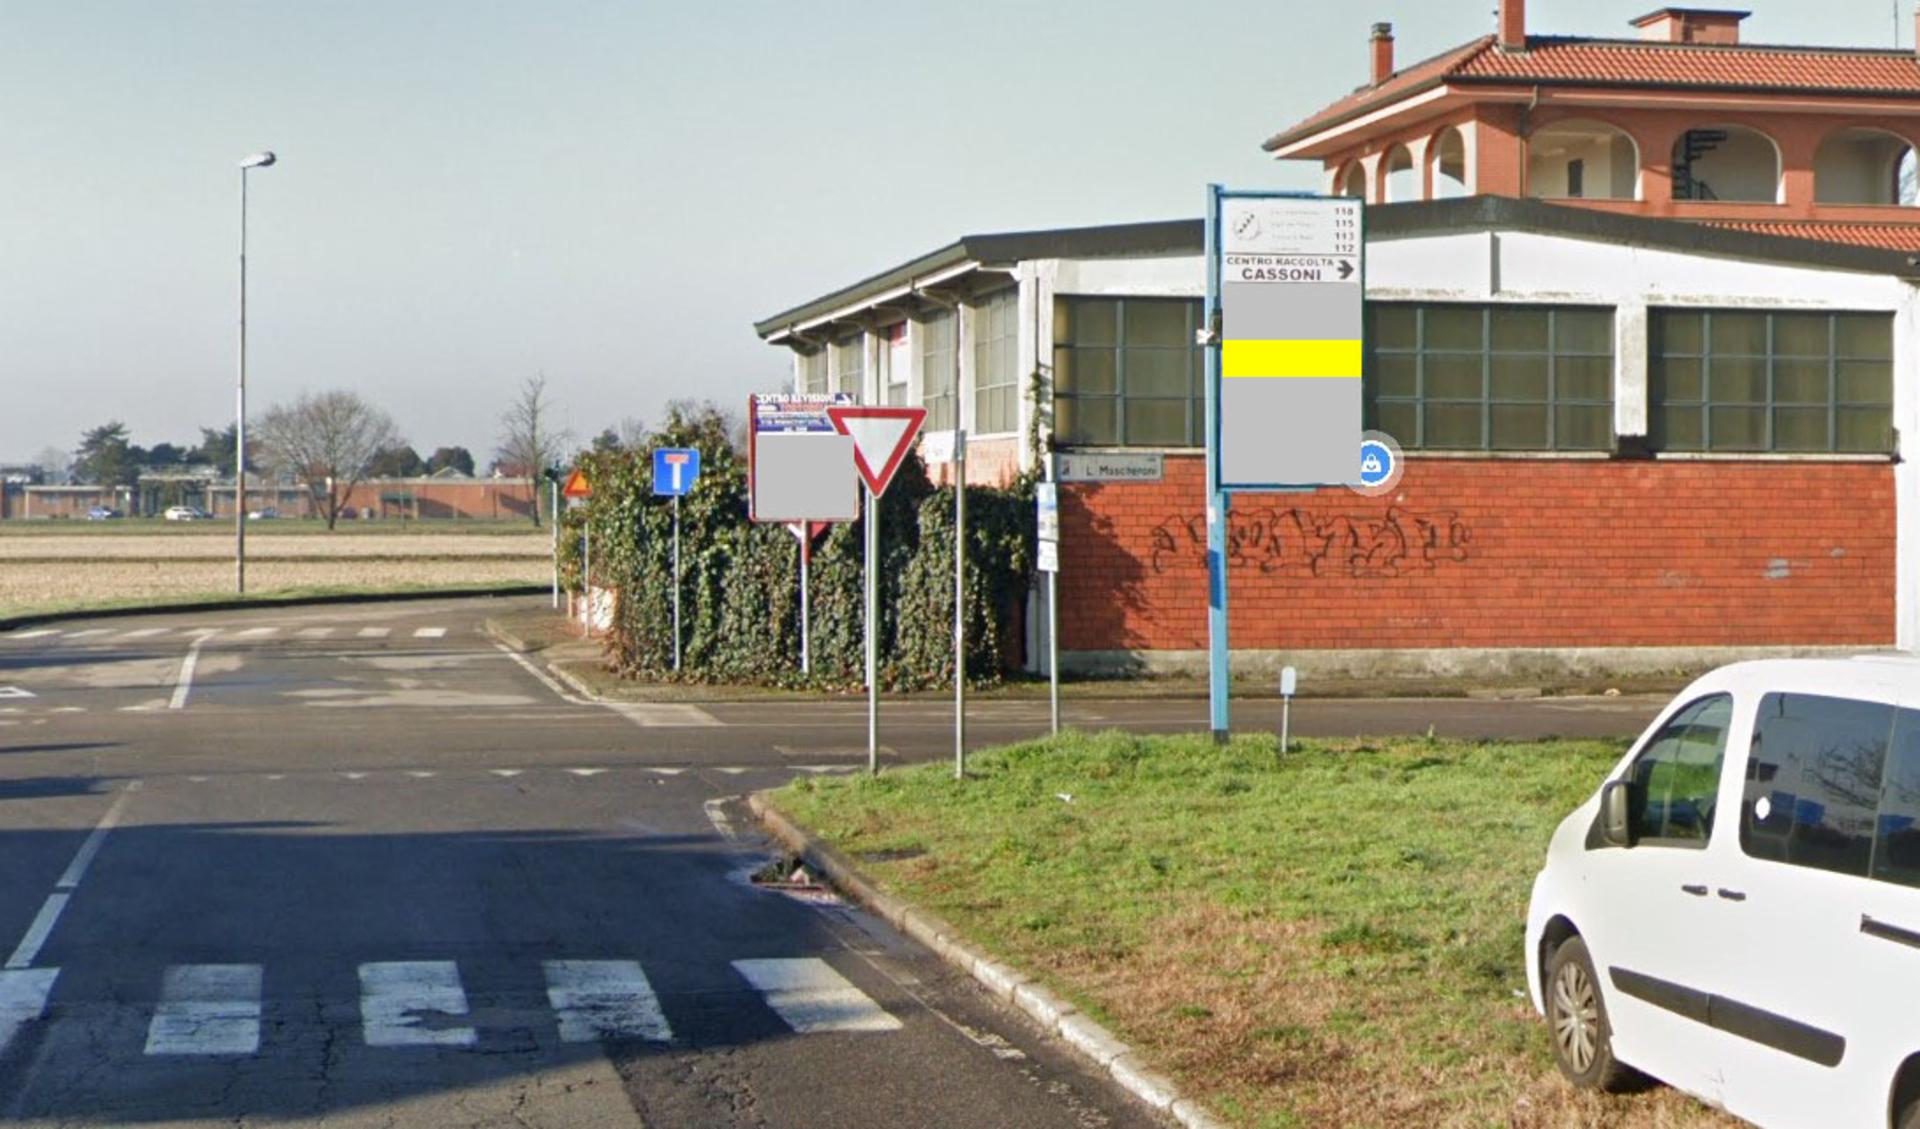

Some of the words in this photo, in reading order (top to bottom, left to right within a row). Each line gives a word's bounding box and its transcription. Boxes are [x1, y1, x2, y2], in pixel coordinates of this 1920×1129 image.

[1335, 207, 1354, 216] 118
[1335, 219, 1354, 228] 115
[1335, 232, 1354, 241] 113
[1335, 244, 1354, 253] 112
[1226, 256, 1273, 265] CENTRO
[1276, 257, 1334, 267] RACCOLTA
[1242, 268, 1321, 281] CASSONI
[1099, 465, 1157, 477] Mascheroni
